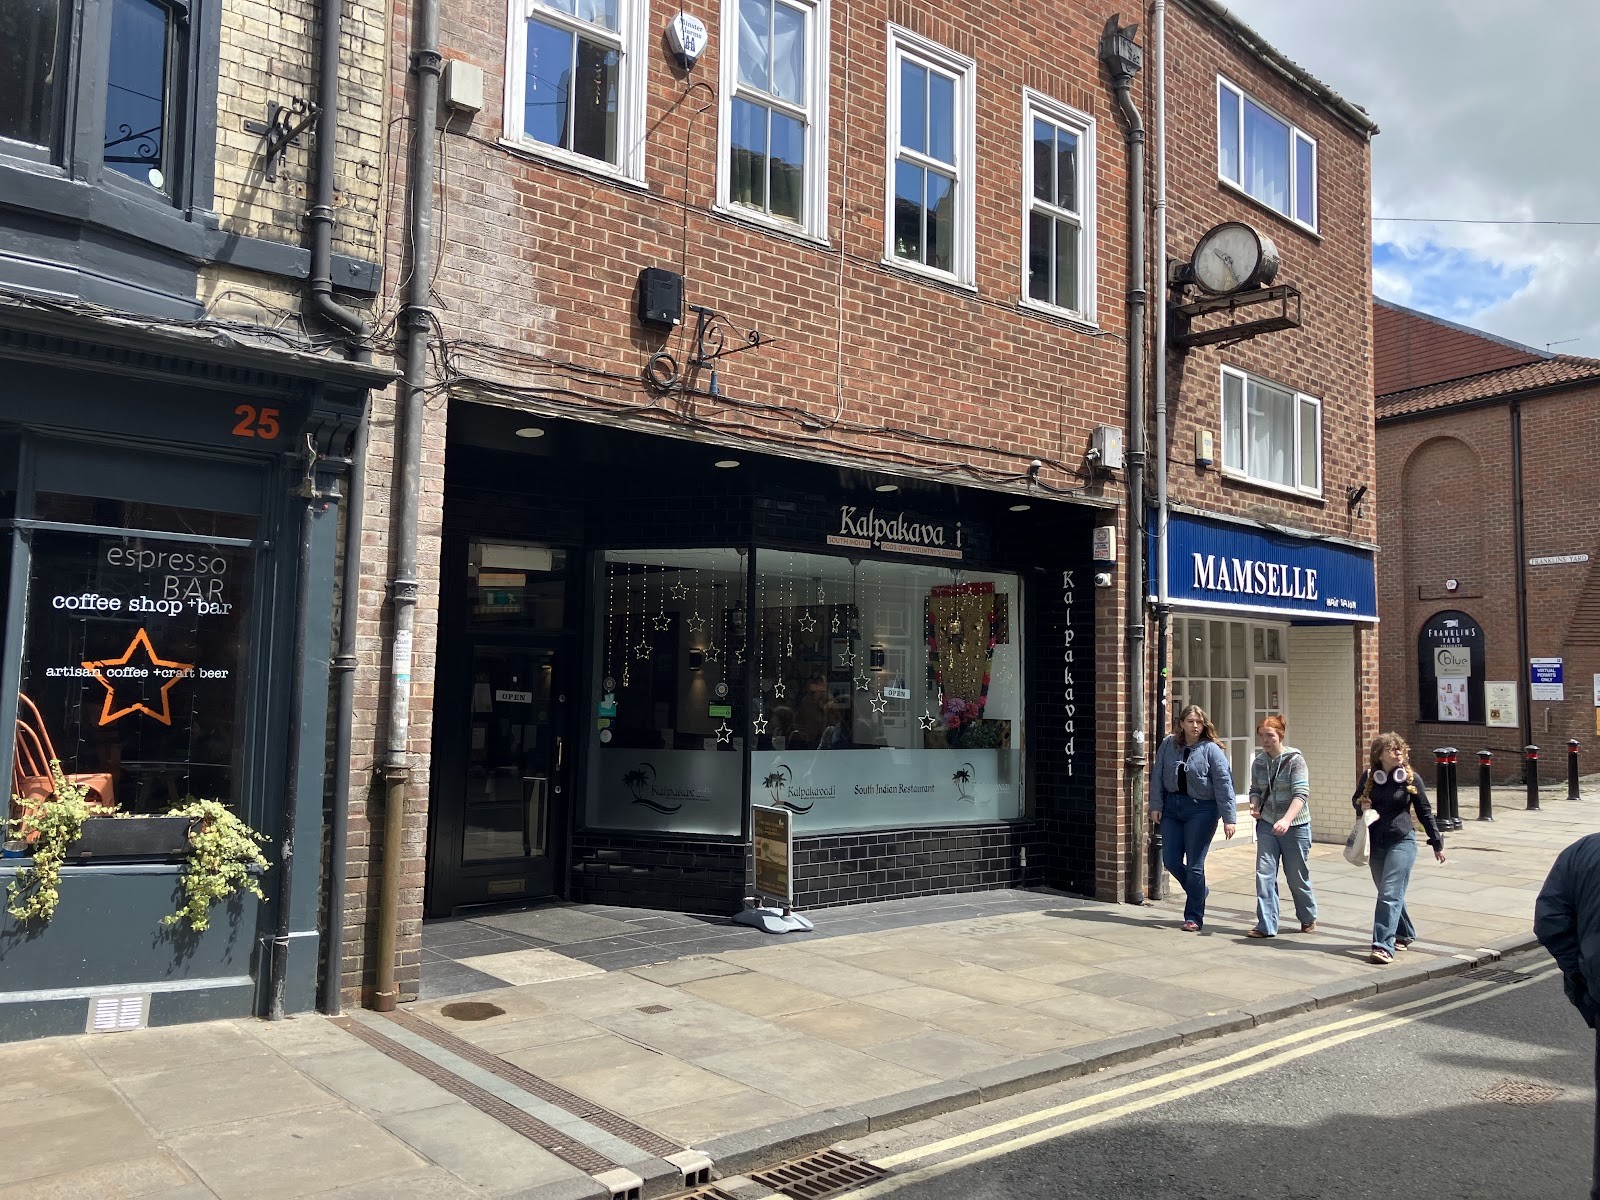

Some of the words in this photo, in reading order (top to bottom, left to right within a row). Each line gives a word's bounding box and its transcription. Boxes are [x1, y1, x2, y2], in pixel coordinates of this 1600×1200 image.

[231, 404, 280, 440] 25
[828, 536, 848, 545] SOUTH
[849, 538, 870, 547] INDIAN
[107, 547, 227, 575] espresso
[1569, 555, 1587, 563] YARD
[1191, 552, 1318, 601] MAMSELLE
[163, 575, 224, 603] BAR
[51, 593, 122, 612] coffee
[128, 595, 183, 617] shop
[1428, 628, 1476, 638] FRANKLINS
[46, 665, 102, 678] artisan
[106, 665, 149, 679] coffee
[199, 666, 229, 679] beer
[501, 692, 527, 702] OPEN
[887, 689, 906, 698] OPEN
[854, 783, 875, 795] South
[875, 783, 898, 795] Indian
[898, 783, 935, 794] Restaurant
